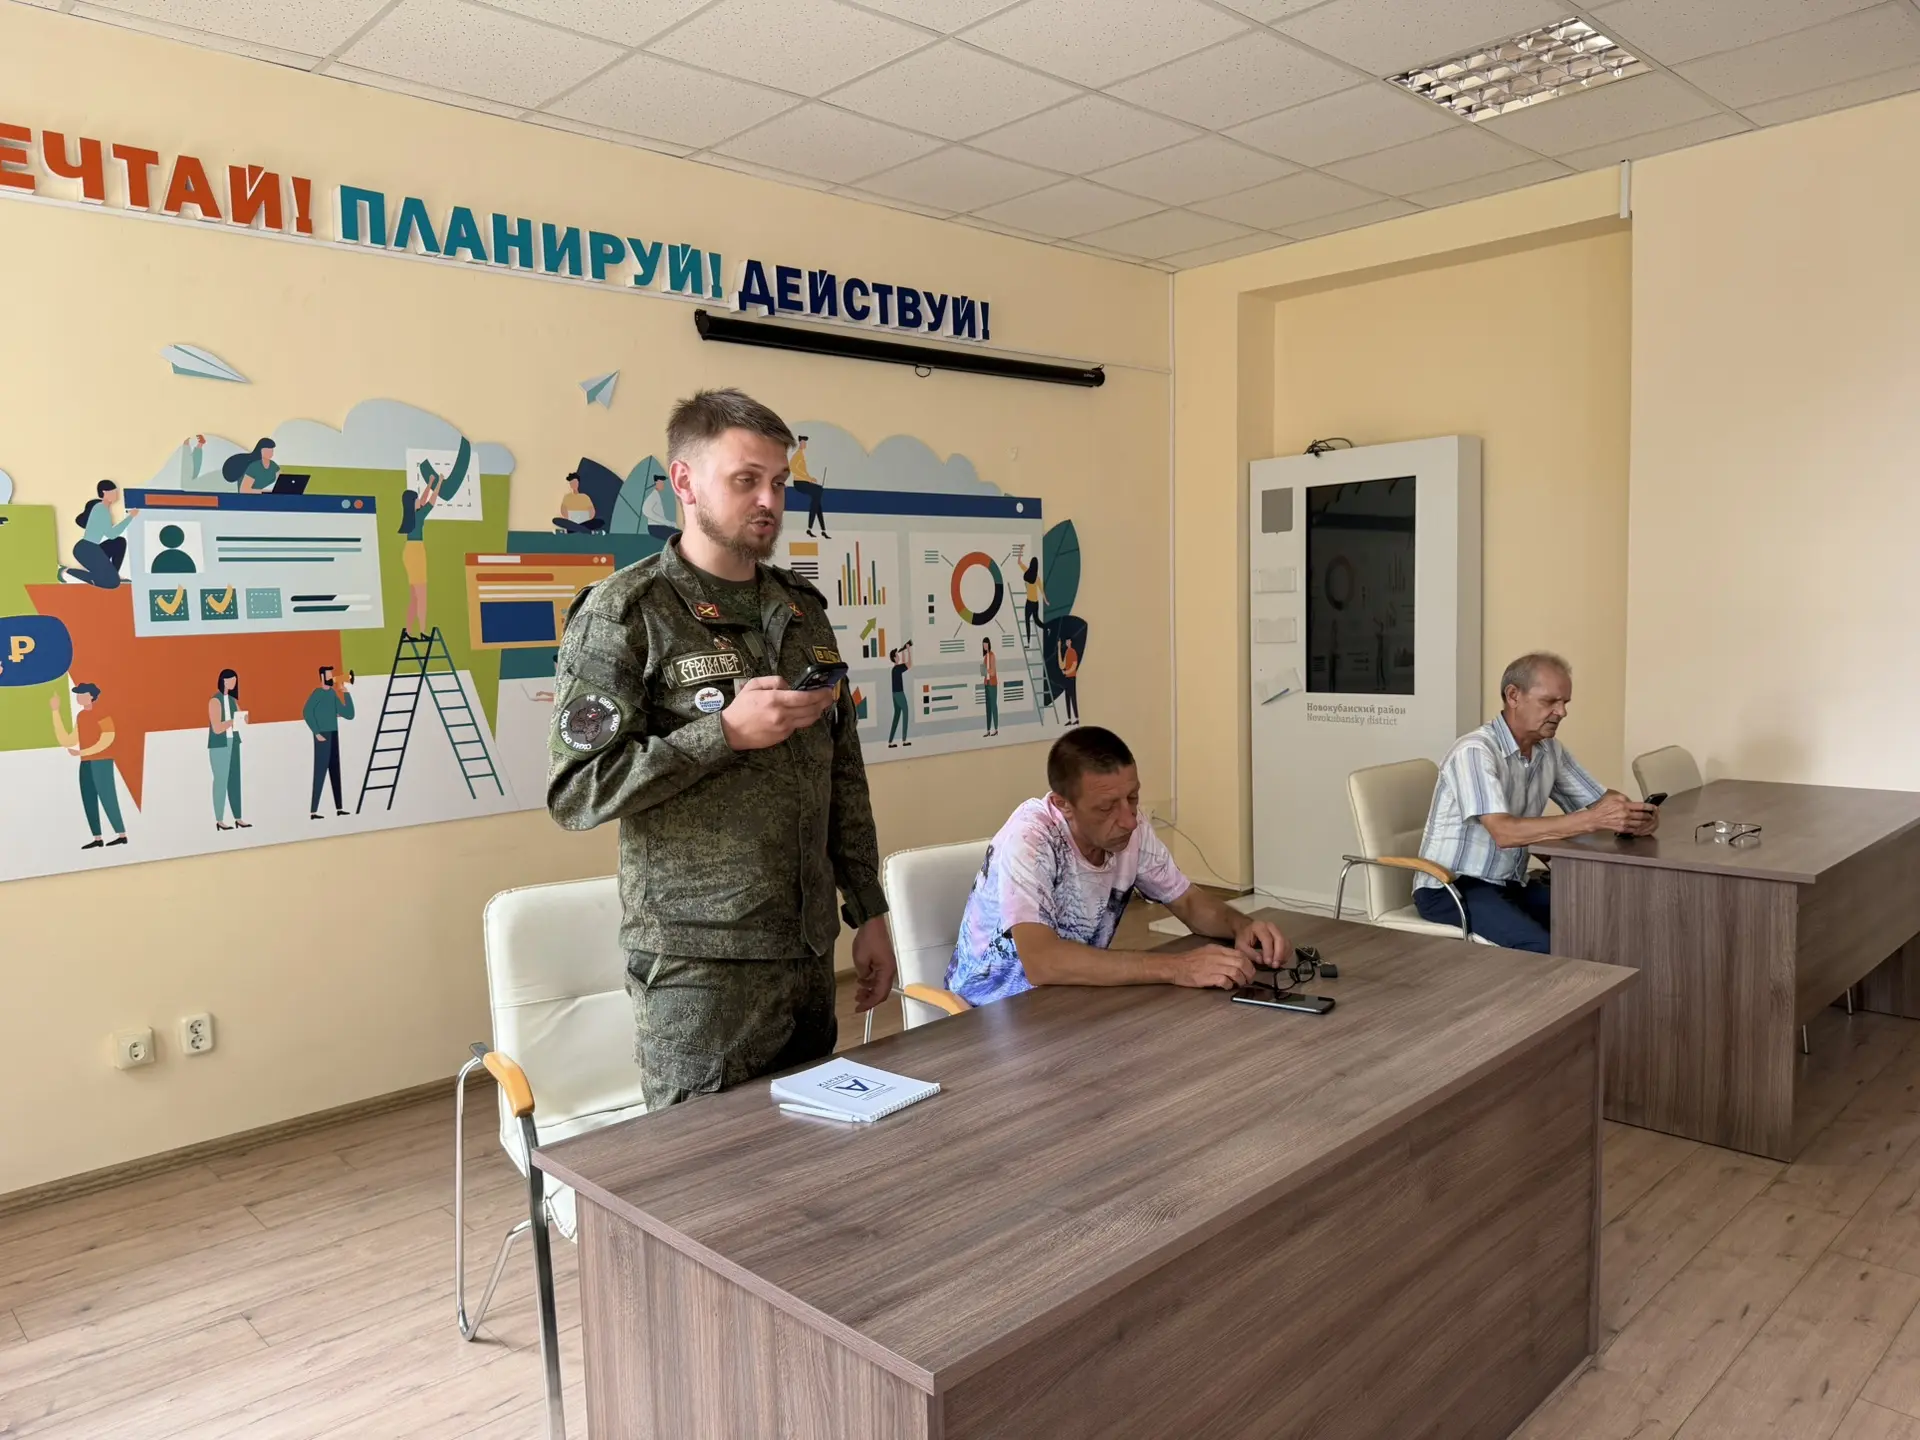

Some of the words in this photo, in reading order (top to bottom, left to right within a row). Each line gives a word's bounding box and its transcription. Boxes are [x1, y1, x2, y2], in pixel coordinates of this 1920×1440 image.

[334, 184, 723, 299] ПЛАНИРУЙ!
[736, 259, 991, 341] ДЕЙСТВУЙ!
[1306, 702, 1376, 714] Новокубанский
[1377, 704, 1406, 716] район
[560, 709, 571, 730] ПОКА
[1306, 712, 1366, 726] Novokubansky
[1366, 715, 1398, 726] district
[561, 730, 573, 744] ОНО
